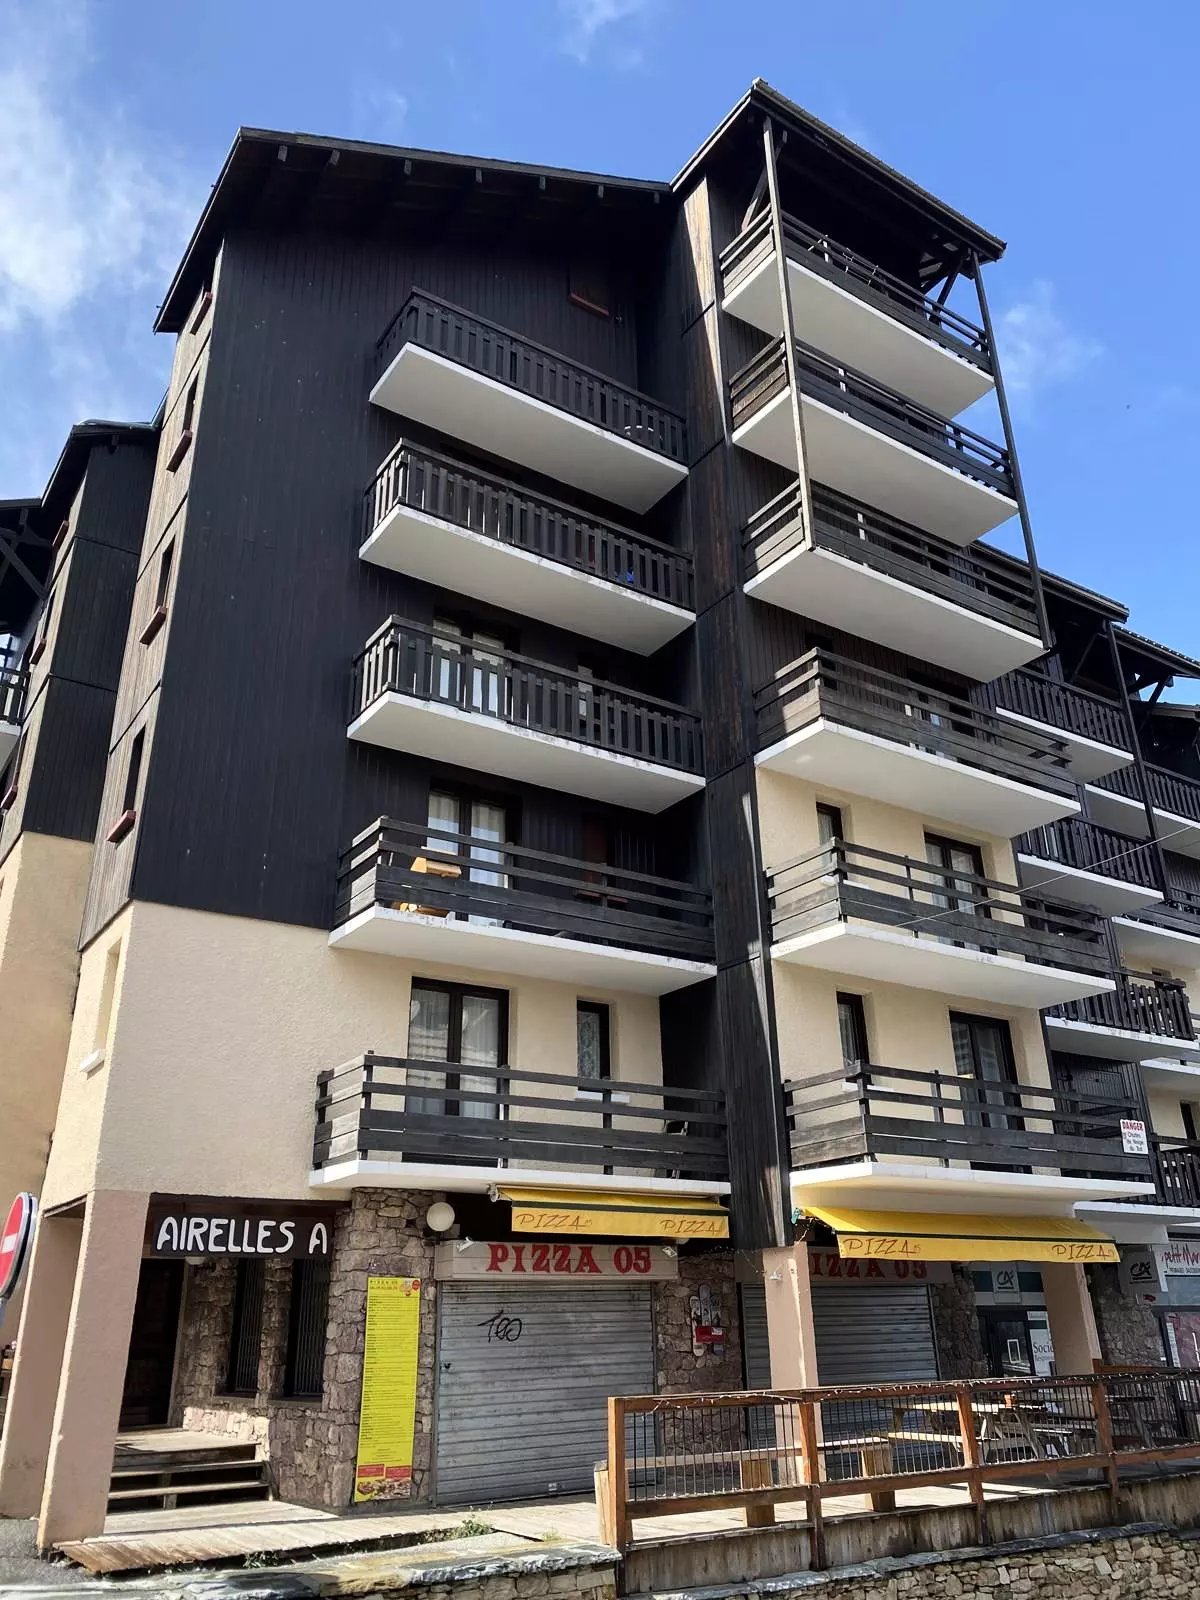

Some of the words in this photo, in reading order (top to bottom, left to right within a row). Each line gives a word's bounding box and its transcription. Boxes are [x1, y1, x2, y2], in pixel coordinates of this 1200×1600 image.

[1122, 1121, 1143, 1131] DANGER
[515, 1213, 587, 1230] PIZZA
[659, 1219, 721, 1237] PIZZA
[156, 1216, 296, 1254] AIRELLES
[308, 1222, 328, 1254] A
[843, 1237, 917, 1258] PIZZA
[1051, 1244, 1111, 1260] PIZZA
[485, 1243, 602, 1274] PIZZA
[613, 1246, 651, 1274] 05
[811, 1253, 886, 1279] IZZA
